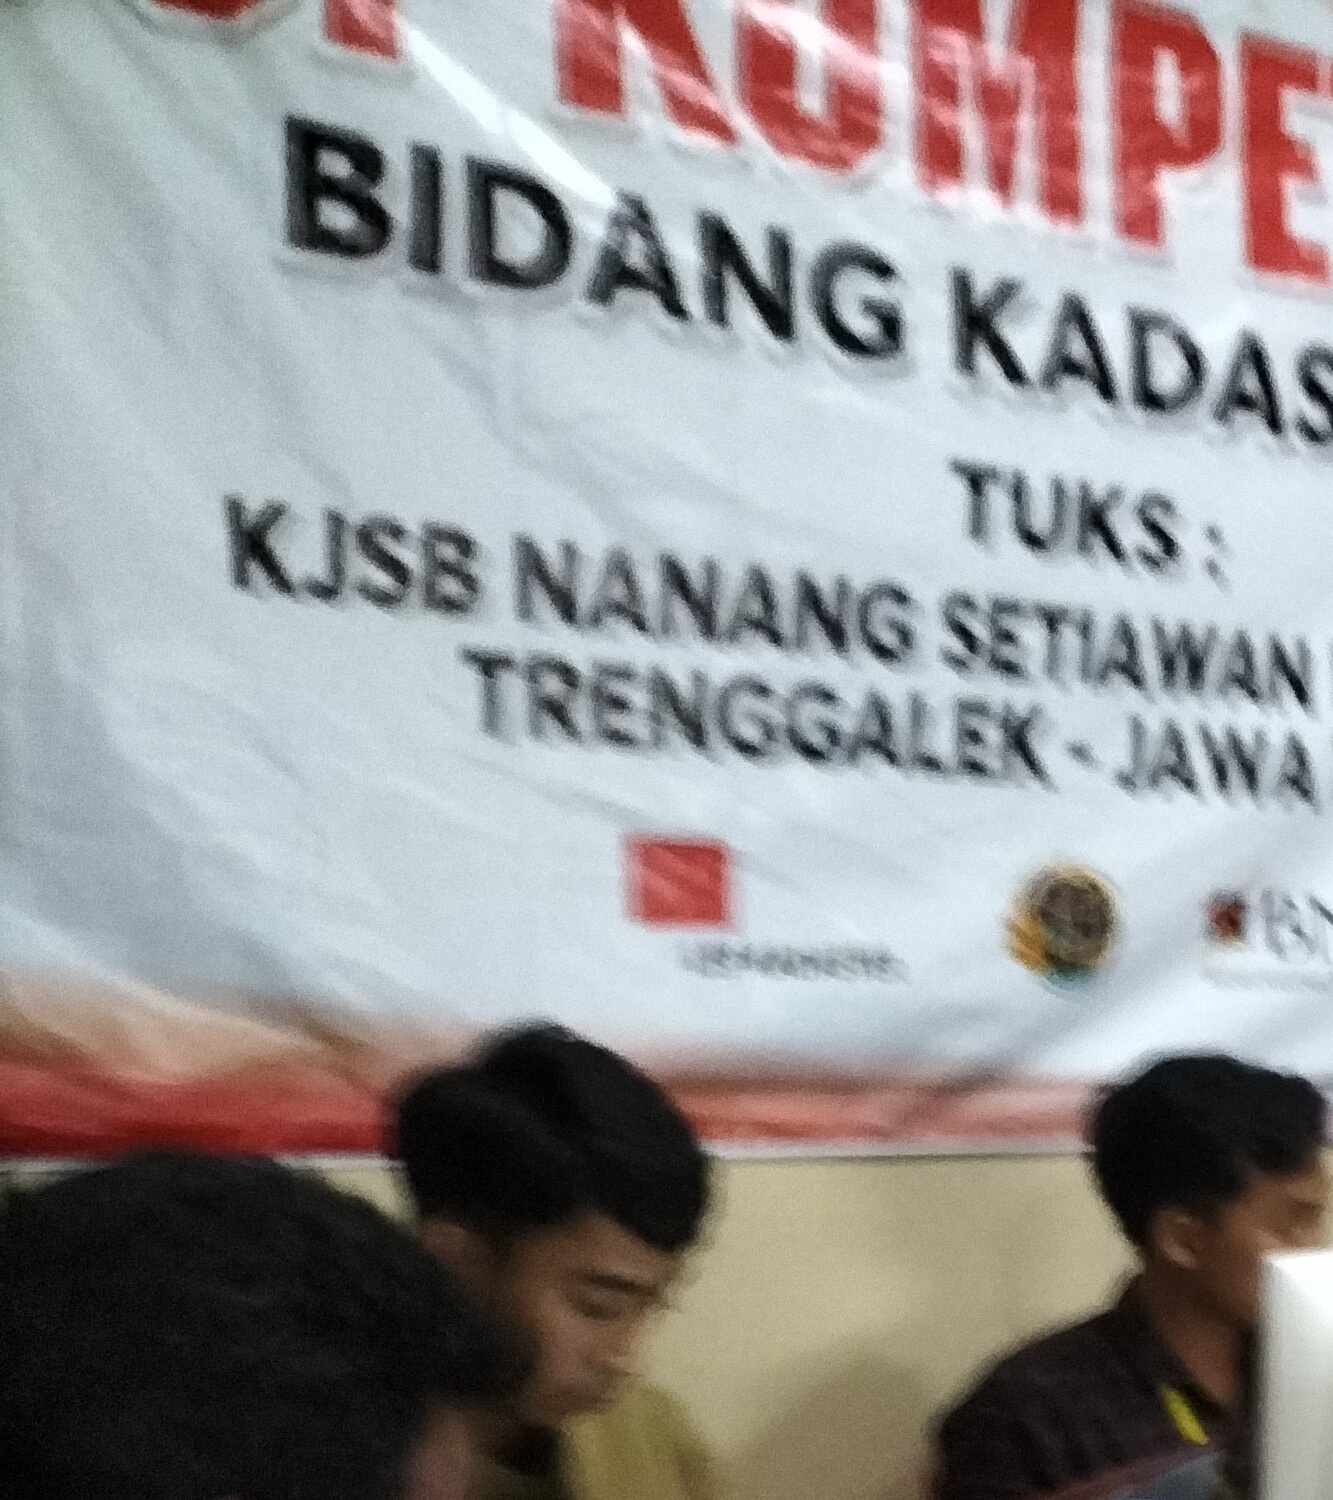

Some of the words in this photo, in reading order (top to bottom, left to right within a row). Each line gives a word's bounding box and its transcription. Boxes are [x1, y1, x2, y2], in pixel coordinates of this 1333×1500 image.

[283, 114, 905, 360] BIDANG
[223, 492, 482, 616] KJSB
[510, 532, 916, 664] NANANG
[938, 592, 1316, 712] SETIAWAN
[948, 458, 1183, 572] TUKS
[459, 647, 1048, 786] TRENGGALEK
[1112, 718, 1318, 806] JAWA
